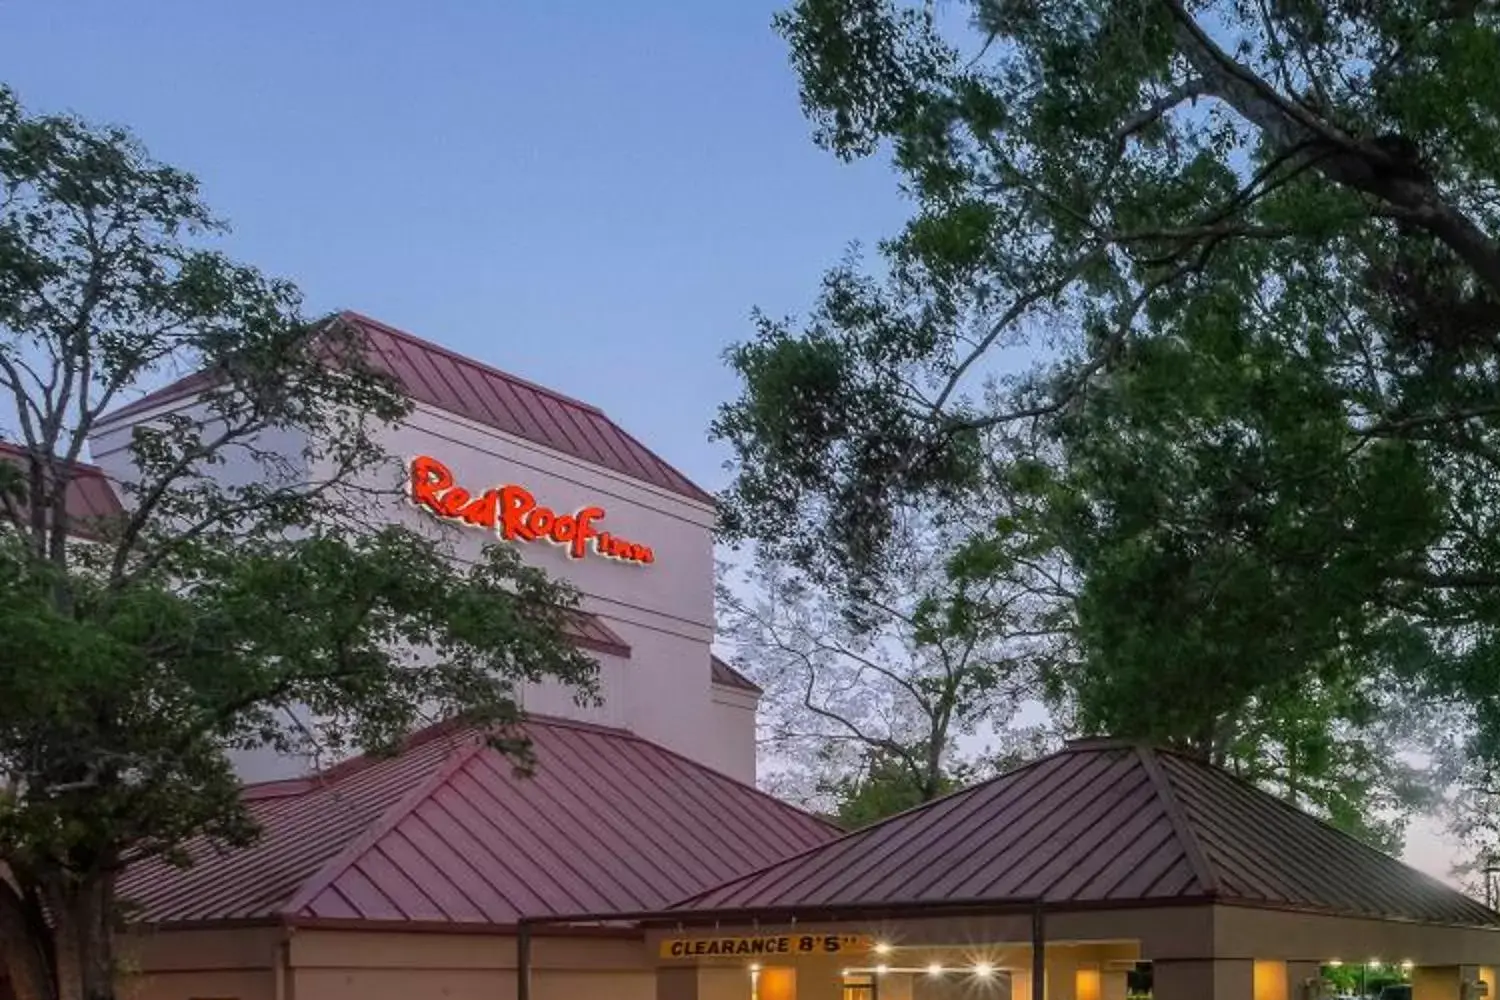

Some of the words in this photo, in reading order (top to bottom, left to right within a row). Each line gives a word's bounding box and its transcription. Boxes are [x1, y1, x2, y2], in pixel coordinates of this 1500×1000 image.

[409, 455, 498, 528] Red
[498, 484, 605, 559] Roof
[598, 531, 655, 565] Inn
[670, 937, 789, 956] CLEARANCE
